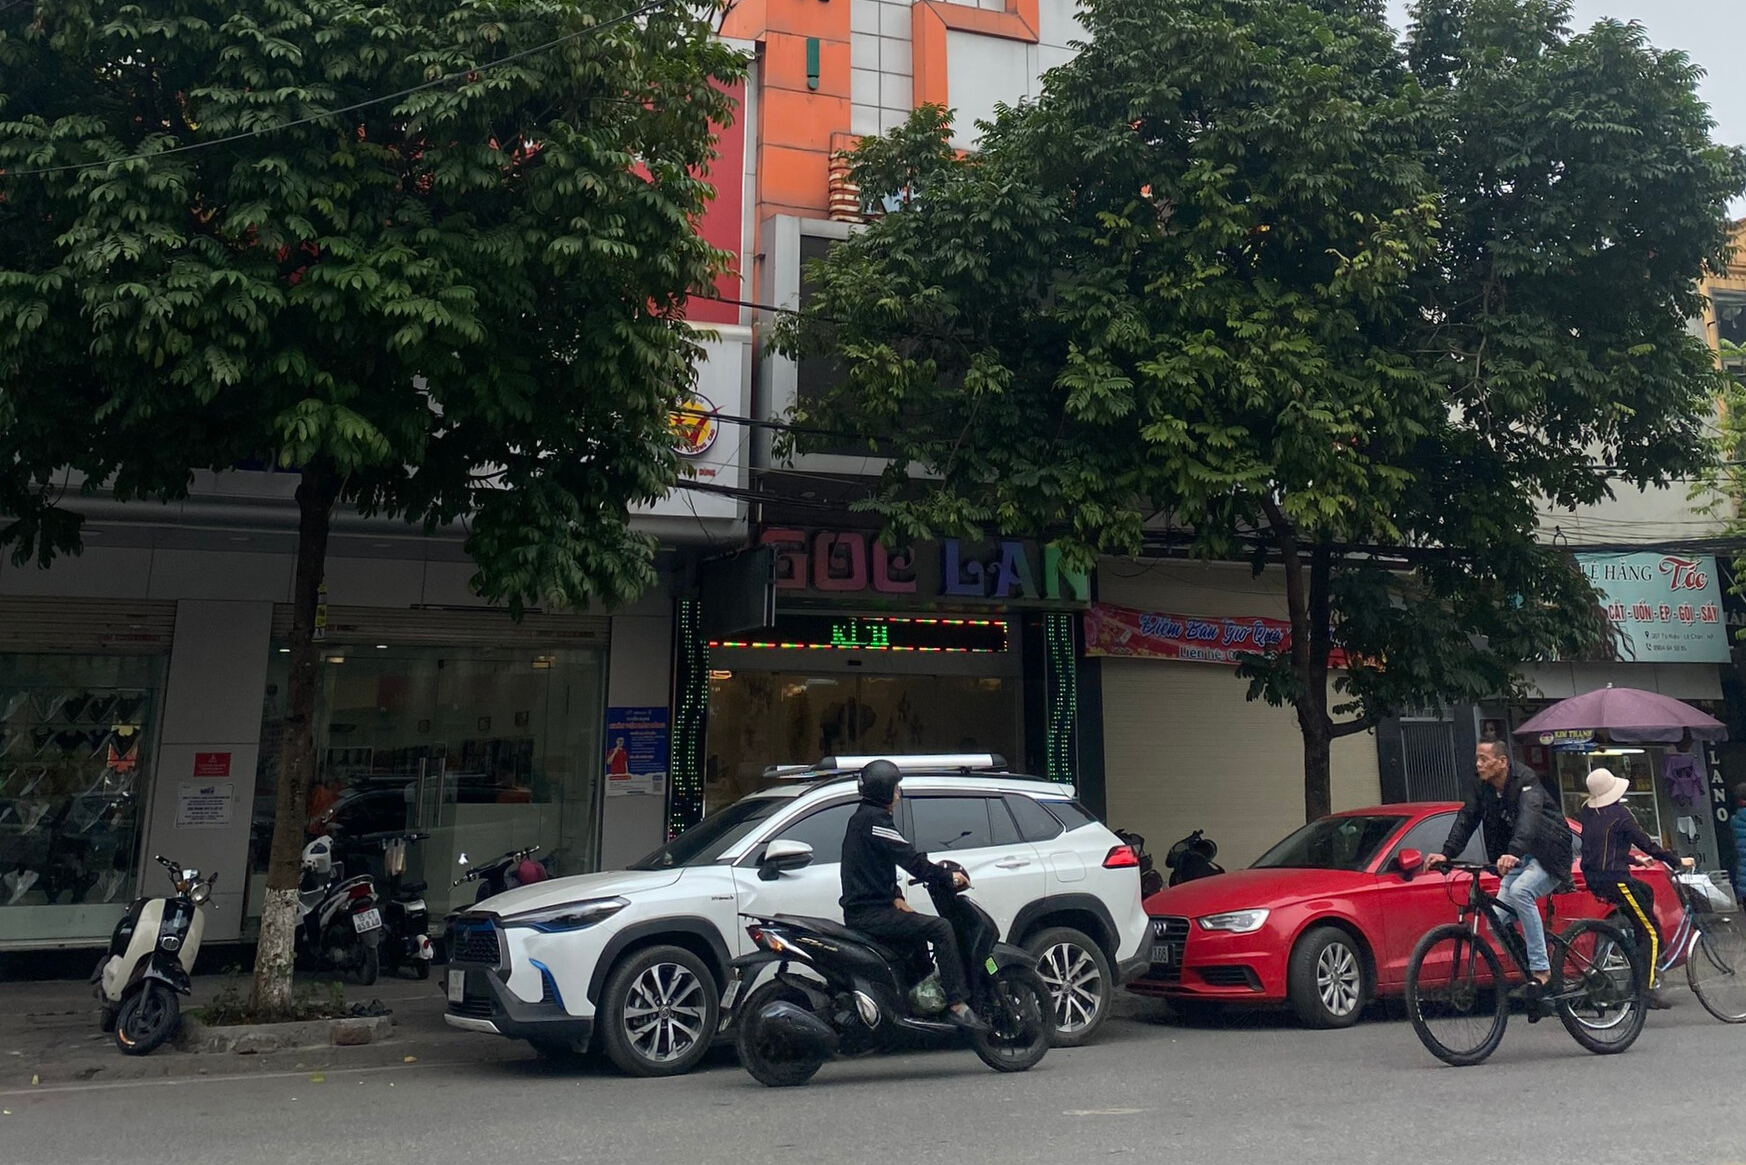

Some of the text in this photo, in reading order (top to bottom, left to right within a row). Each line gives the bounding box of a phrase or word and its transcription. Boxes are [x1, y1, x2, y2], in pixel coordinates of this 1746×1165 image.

[943, 537, 1089, 601] LAN
[1604, 557, 1652, 582] HẰNG
[1607, 599, 1626, 622] CẮT
[1632, 597, 1653, 623] UỐN
[1678, 602, 1695, 626] GỘI
[1700, 602, 1719, 624] SẤY
